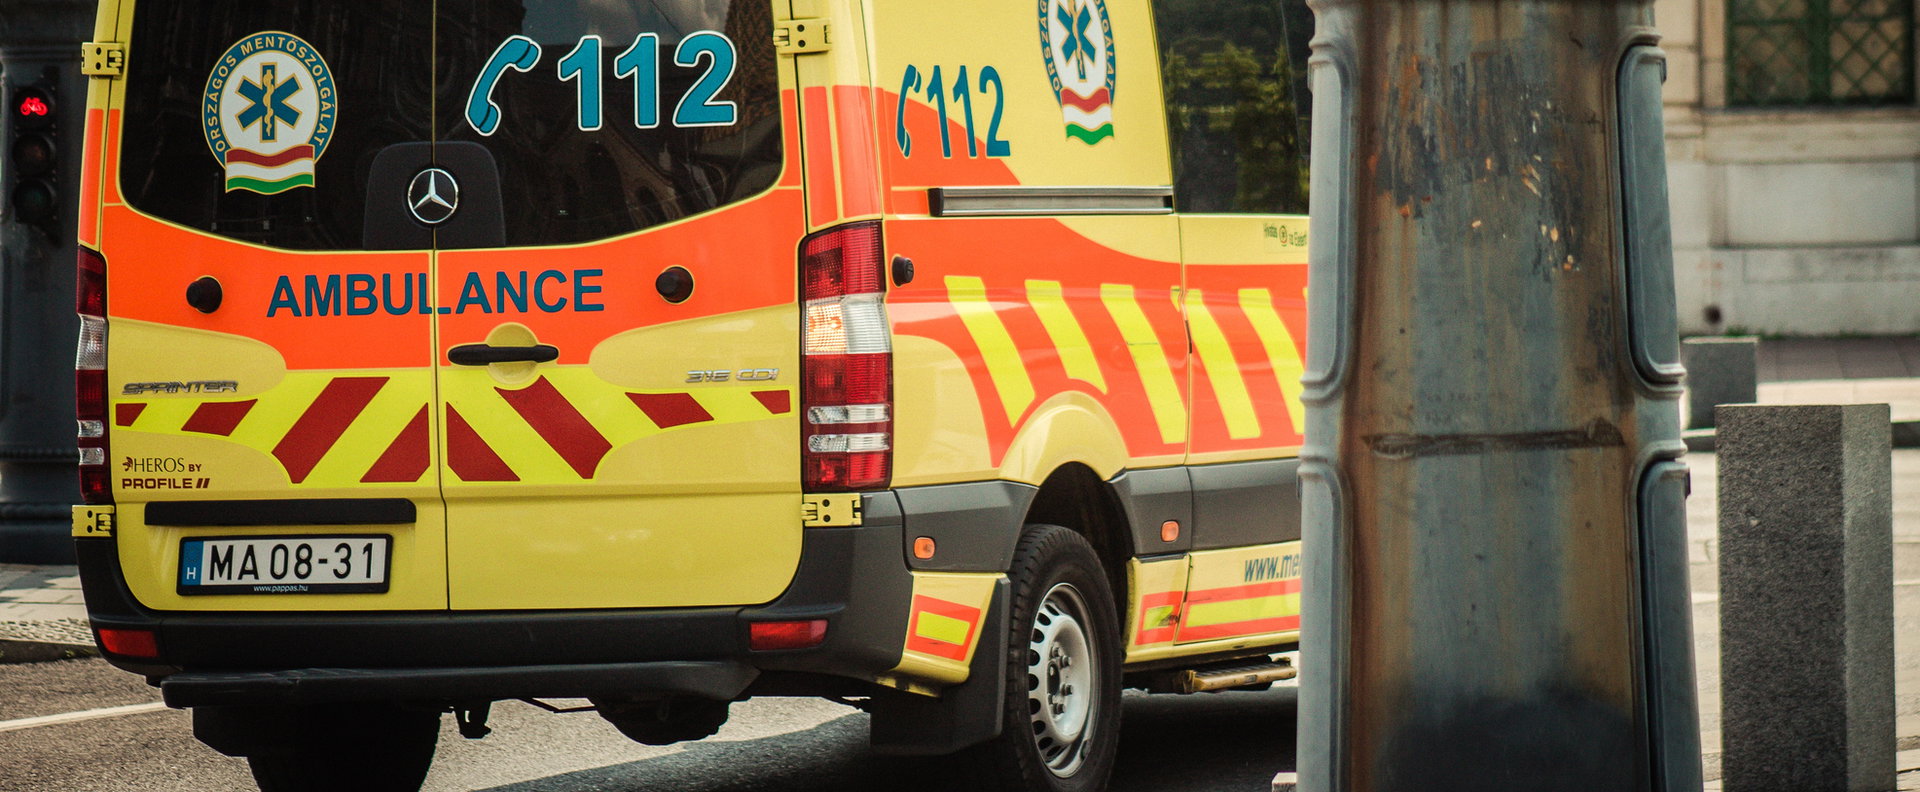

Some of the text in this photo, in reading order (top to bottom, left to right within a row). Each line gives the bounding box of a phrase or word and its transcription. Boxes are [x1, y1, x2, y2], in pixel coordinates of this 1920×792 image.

[557, 30, 738, 131] 112
[207, 36, 335, 152] ORSZÁGOS MENTŐSZOLGÁLAT
[926, 64, 1011, 158] 112
[266, 269, 605, 317] AMBULANCE
[736, 368, 779, 381] CDI
[121, 380, 239, 395] SPRINTER
[134, 457, 202, 473] HEROS BY
[122, 478, 193, 489] PROFILE
[209, 542, 374, 581] MA 08-31
[1244, 554, 1301, 582] www.me
[186, 567, 196, 580] H
[253, 584, 309, 593] www.pappas.hu
